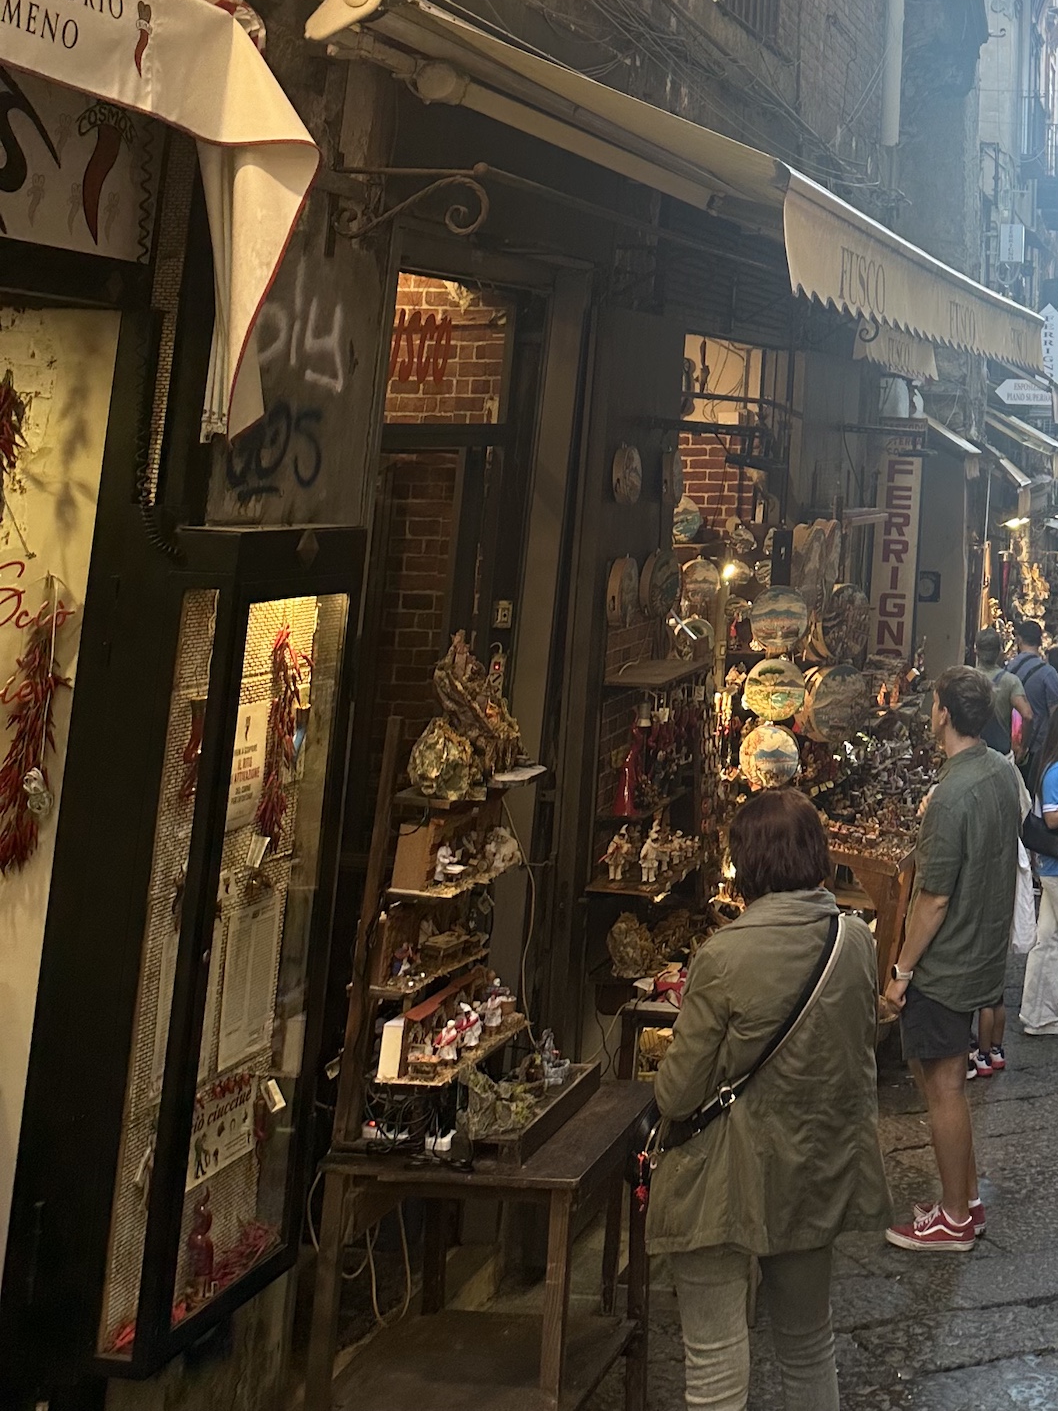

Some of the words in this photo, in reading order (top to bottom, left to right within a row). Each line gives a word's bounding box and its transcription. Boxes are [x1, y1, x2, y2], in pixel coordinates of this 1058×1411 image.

[77, 101, 136, 144] COSMOS
[838, 246, 886, 315] FUSCO
[1026, 393, 1051, 402] SUPERIO
